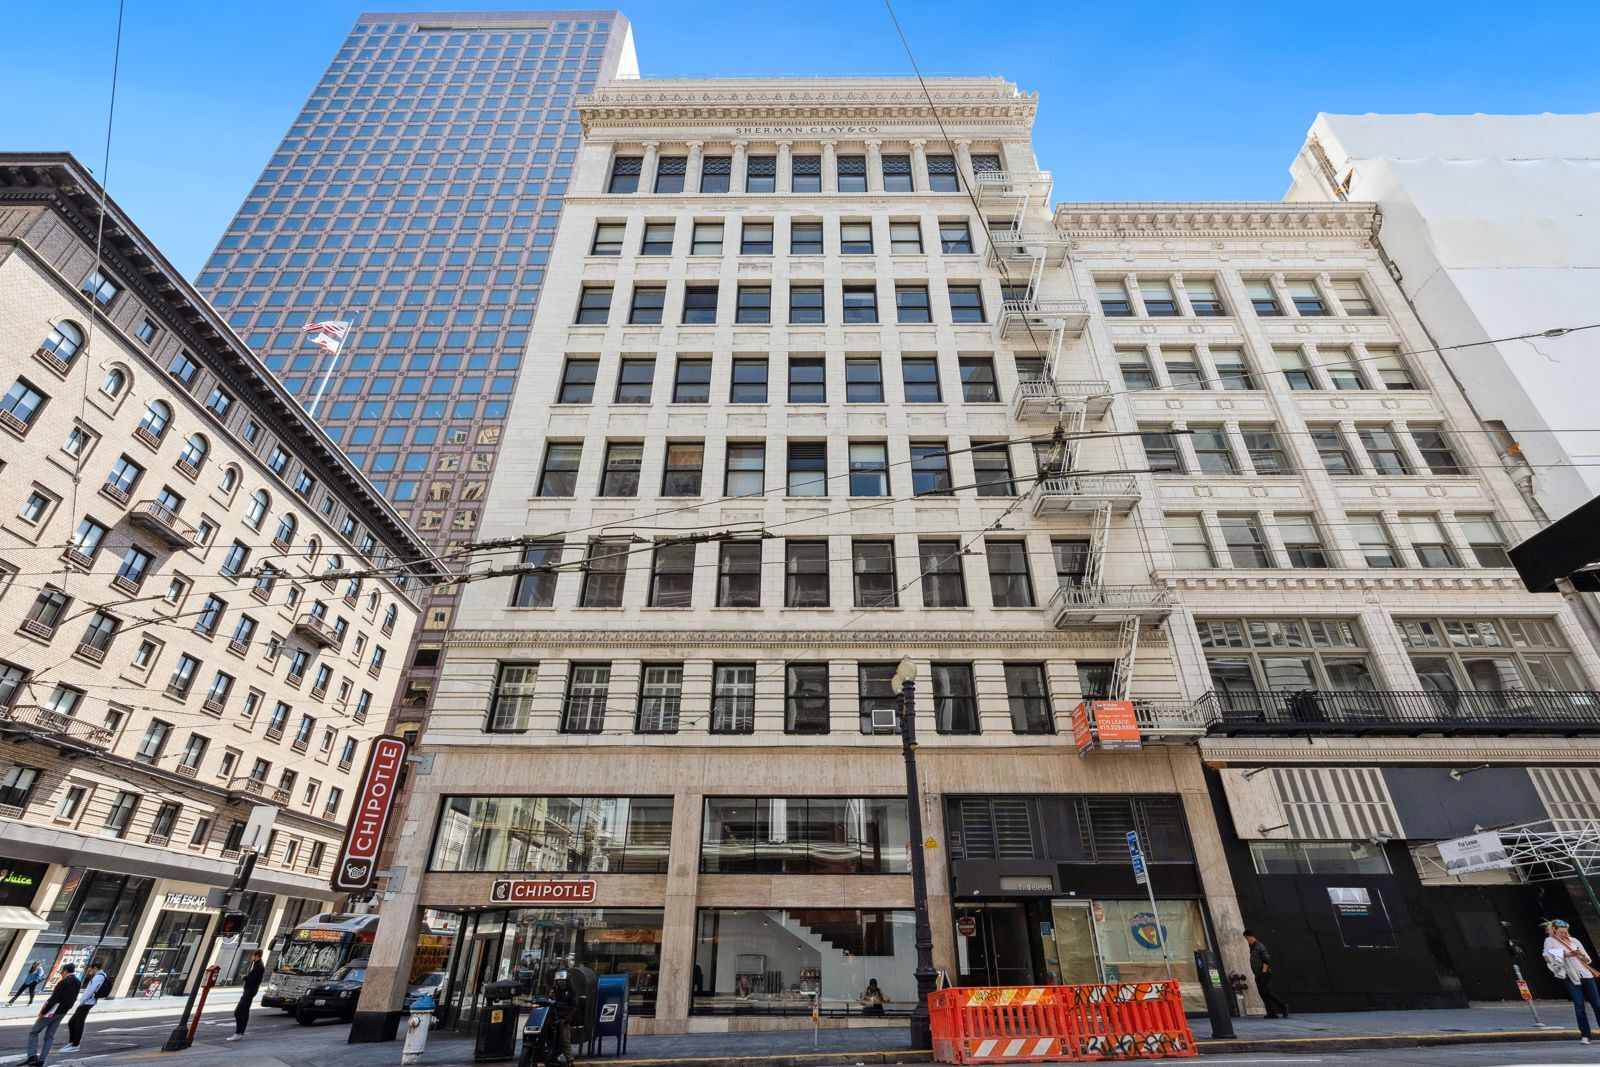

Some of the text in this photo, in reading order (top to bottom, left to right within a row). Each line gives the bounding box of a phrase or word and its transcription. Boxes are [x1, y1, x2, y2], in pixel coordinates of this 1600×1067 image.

[356, 746, 397, 851] CHIPOTLE
[1465, 839, 1479, 847] Lease
[5, 872, 33, 885] juice
[515, 885, 591, 897] CHIPOTLE
[166, 893, 208, 906] THE ESCAP
[299, 929, 310, 939] 45
